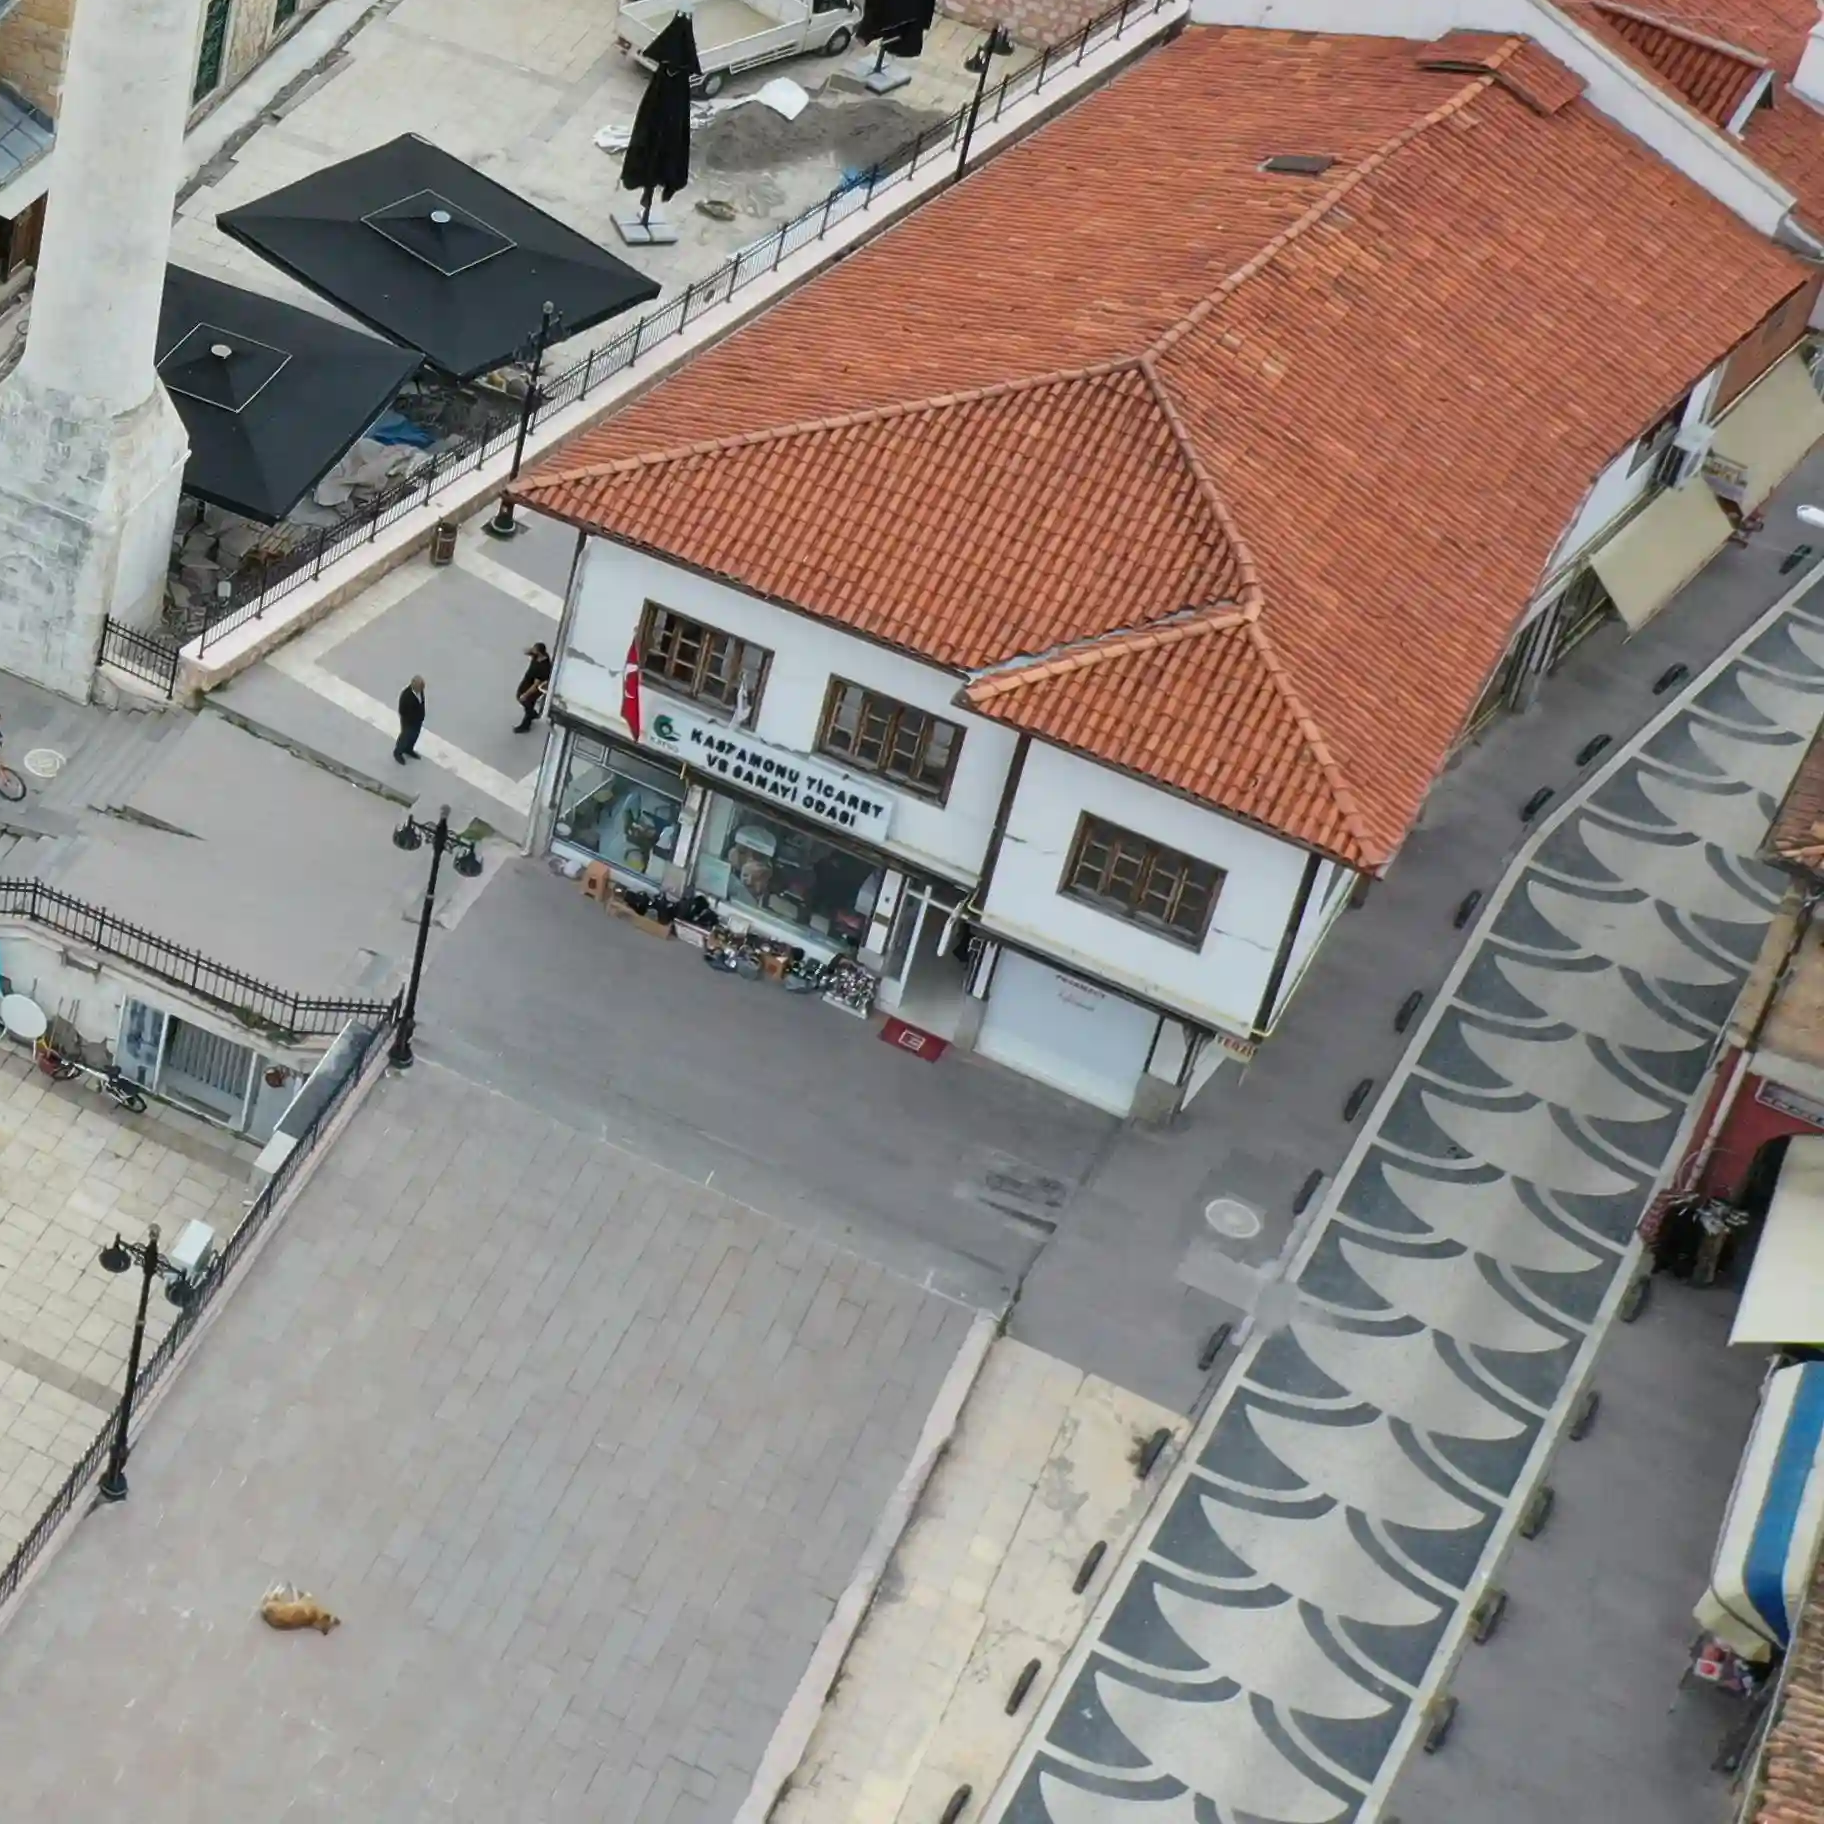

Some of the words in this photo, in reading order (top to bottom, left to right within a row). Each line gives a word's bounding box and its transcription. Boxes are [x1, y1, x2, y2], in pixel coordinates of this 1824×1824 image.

[690, 727, 801, 784] KASTAMONU
[806, 776, 885, 819] TİCARET
[705, 753, 729, 774] VE
[732, 767, 798, 803] SANAYİ
[802, 794, 856, 827] ODASI
